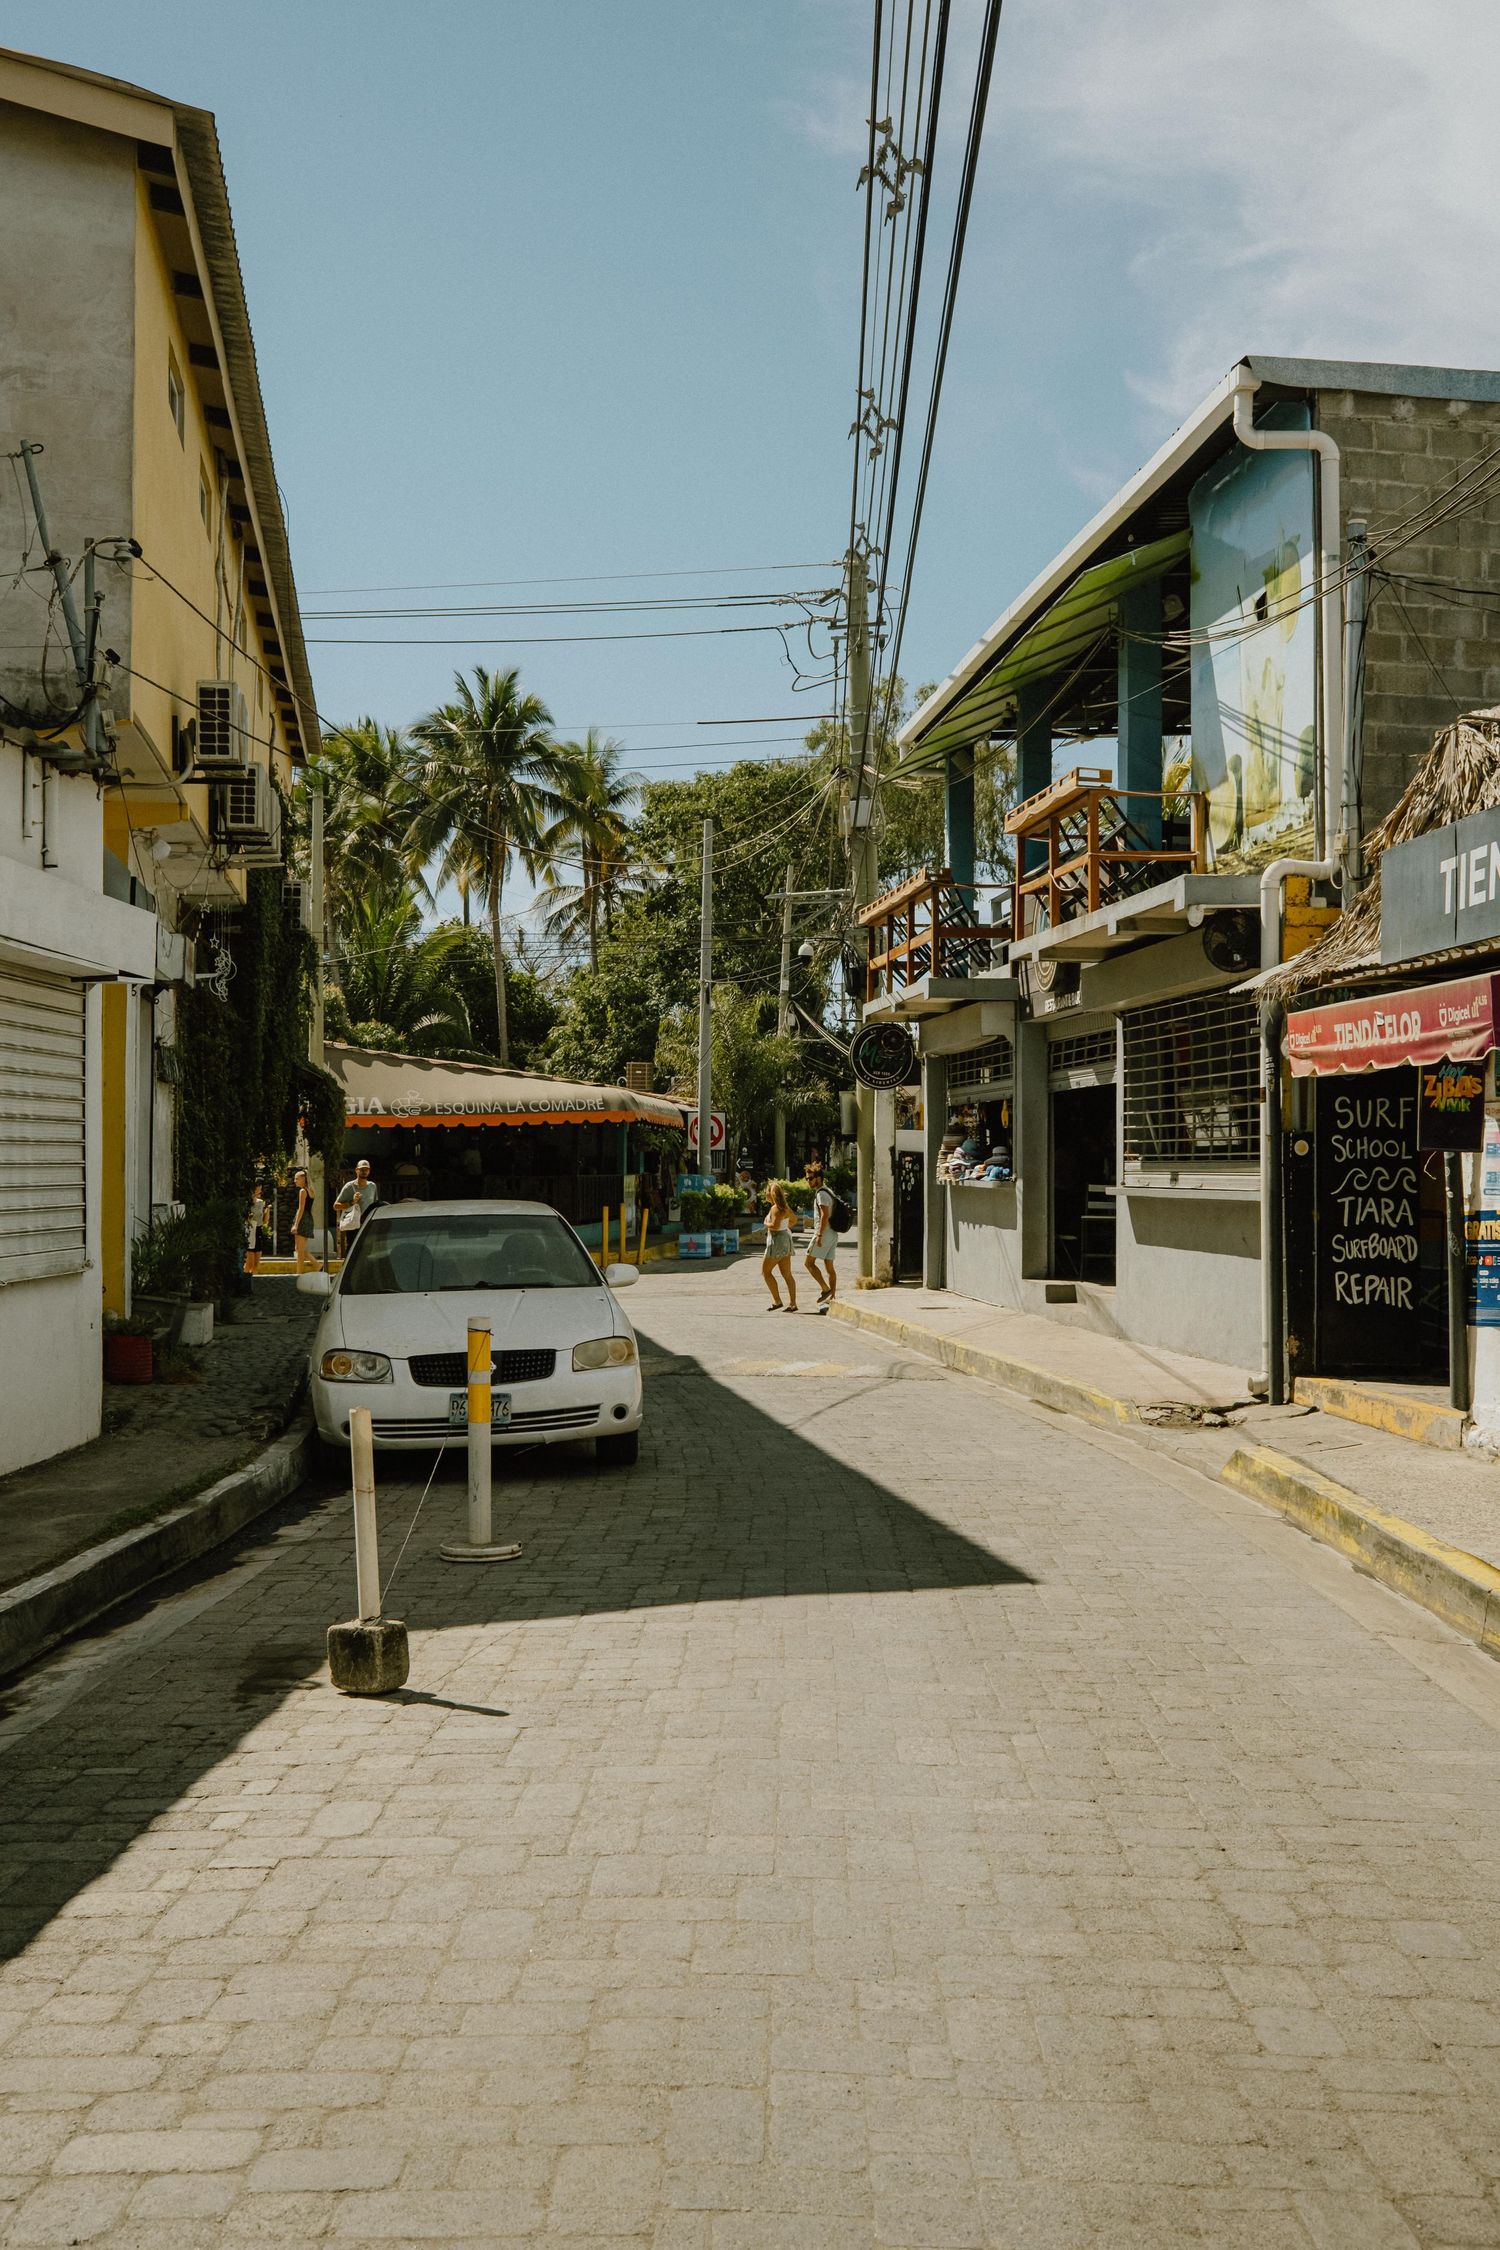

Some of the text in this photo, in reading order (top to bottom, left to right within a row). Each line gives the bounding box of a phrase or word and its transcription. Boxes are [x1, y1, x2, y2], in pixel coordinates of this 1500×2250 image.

[1334, 1010, 1421, 1051] TIENDA FLOR
[1448, 1004, 1471, 1026] Digicel
[435, 1098, 605, 1115] ESQUINA LA COMADRE
[1335, 1096, 1414, 1129] SURF
[1331, 1134, 1413, 1163] SCHOOL
[1337, 1196, 1414, 1228] TIARA
[1332, 1232, 1418, 1264] SURFBOARD
[1335, 1270, 1414, 1310] REPAIR
